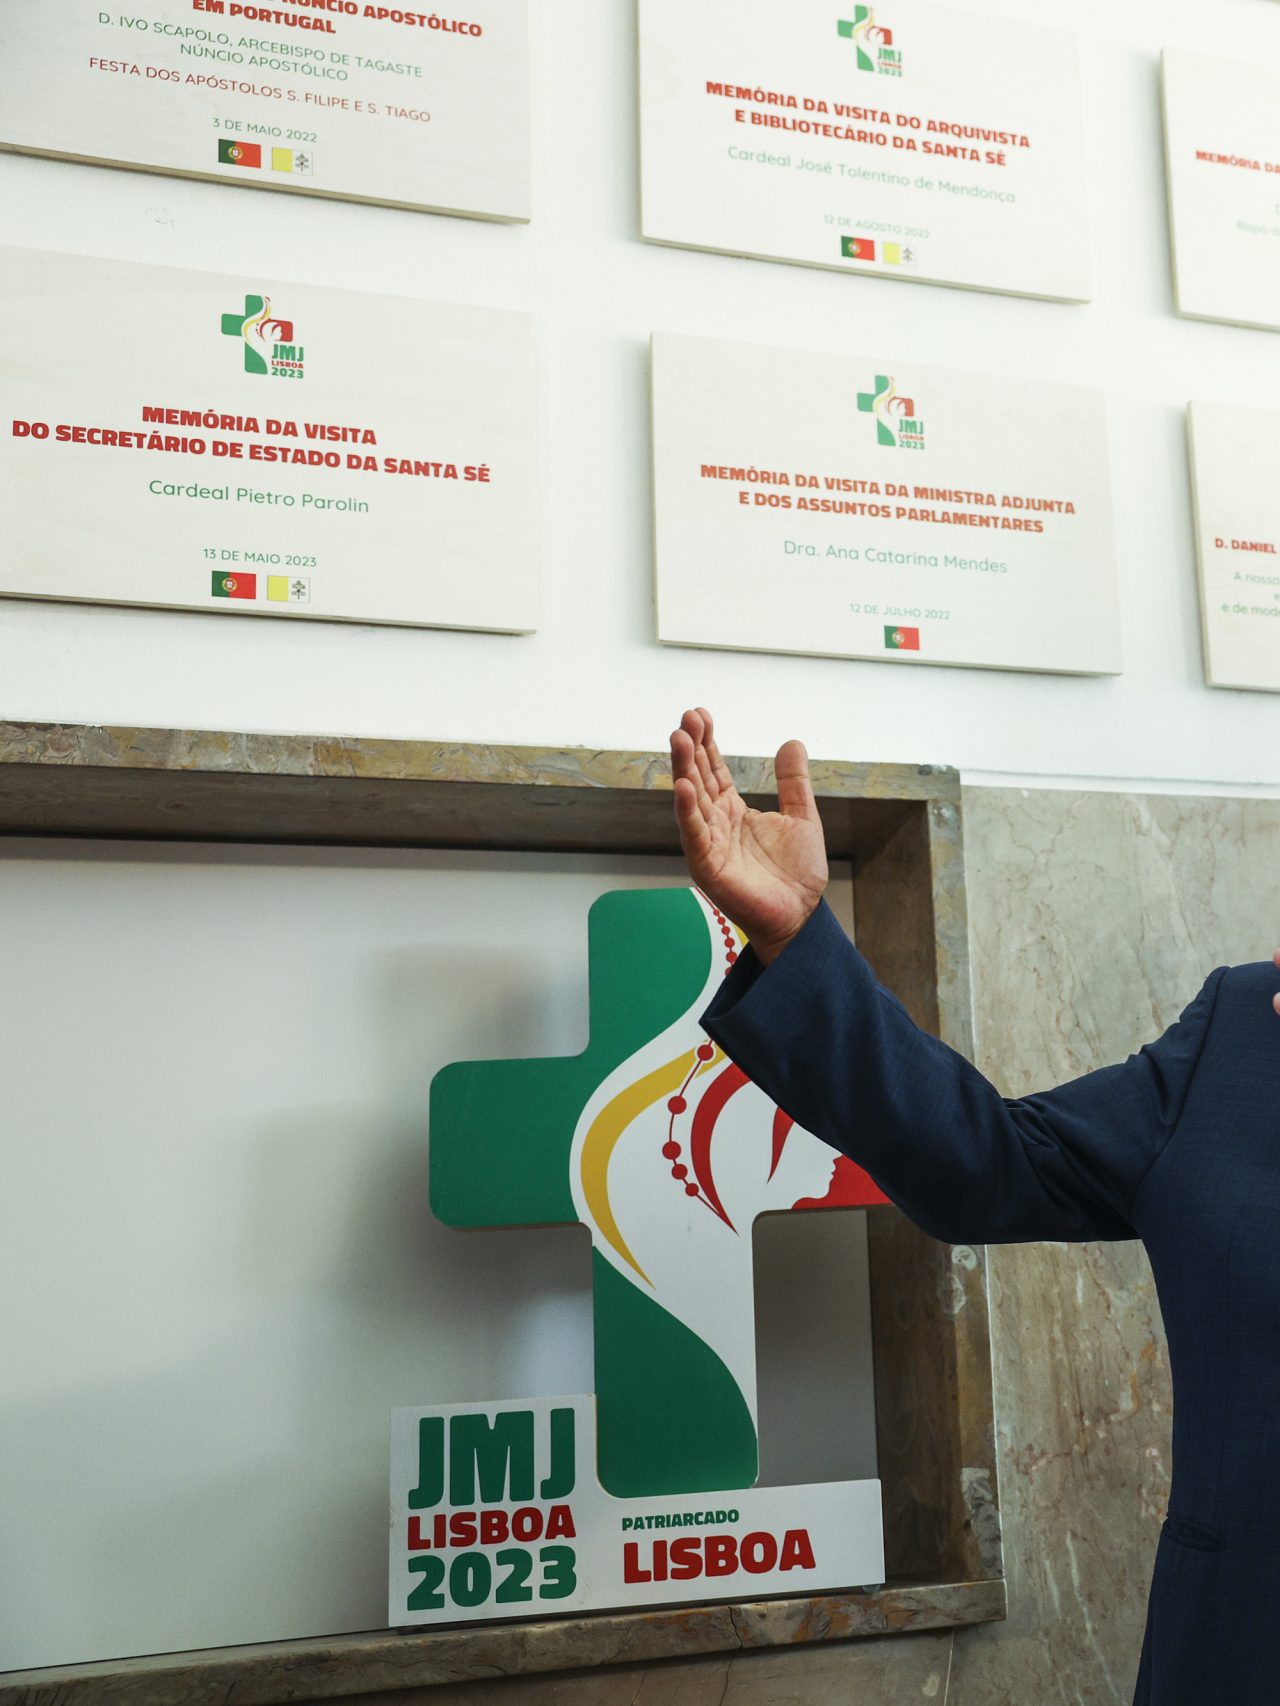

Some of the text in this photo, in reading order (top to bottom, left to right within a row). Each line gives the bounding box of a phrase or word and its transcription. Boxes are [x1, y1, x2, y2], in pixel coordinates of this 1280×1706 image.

[193, 0, 336, 33] EM PORTUGAL
[281, 0, 482, 37] NCIO APOSTÓLICO
[99, 13, 421, 77] D. IVO SCAPOLO, ARCEBISPO DE TAGASTE
[878, 47, 902, 63] JMJ
[181, 44, 348, 80] NÚNCIO APOSTÓLICO
[90, 58, 431, 122] FESTA DOS APÓSTOLOS S. FILIPE E S. TIAGO
[213, 118, 317, 143] 3 DE MAIO 2022
[706, 81, 1030, 148] MEMÓRIA DA VISITA DO ARQUIVISTA
[735, 109, 1006, 166] E BIBLIOTECÁRIO DA SANTA SÉ
[728, 146, 1015, 203] Cardeal José Tolentino de Mendonça
[1196, 150, 1260, 170] MEMÓRIA
[824, 214, 929, 239] 12 DE AGOSTO 2022
[271, 344, 304, 362] JMJ
[271, 360, 304, 369] LISBOA
[271, 367, 304, 379] 2023
[143, 406, 376, 445] MEMÓRIA DA VISITA
[898, 419, 924, 434] JMJ
[13, 420, 490, 482] DO SECRETÁRIO DE ESTADO DA SANTA SÉ
[899, 440, 925, 450] 2023
[149, 480, 368, 512] Cardeal Pietro Parolin
[701, 464, 1075, 514] MEMÓRIA DA VISITA DA MINISTRA ADJUNTA
[739, 491, 1043, 533] E DOS ASSUNTOS PARLAMENTARES
[203, 549, 317, 567] 13 DE MAIO 2023
[784, 540, 1008, 573] Dra. Ana Catarina Mendes
[1215, 537, 1228, 549] D.
[1231, 539, 1277, 554] DANIEL
[849, 603, 950, 620] 12 DE JULHO 2022
[408, 1407, 576, 1510] JMJ
[407, 1504, 577, 1551] LISBOA
[621, 1508, 740, 1532] PATRIARCADO
[623, 1528, 816, 1584] LISBOA
[406, 1545, 577, 1611] 2023
